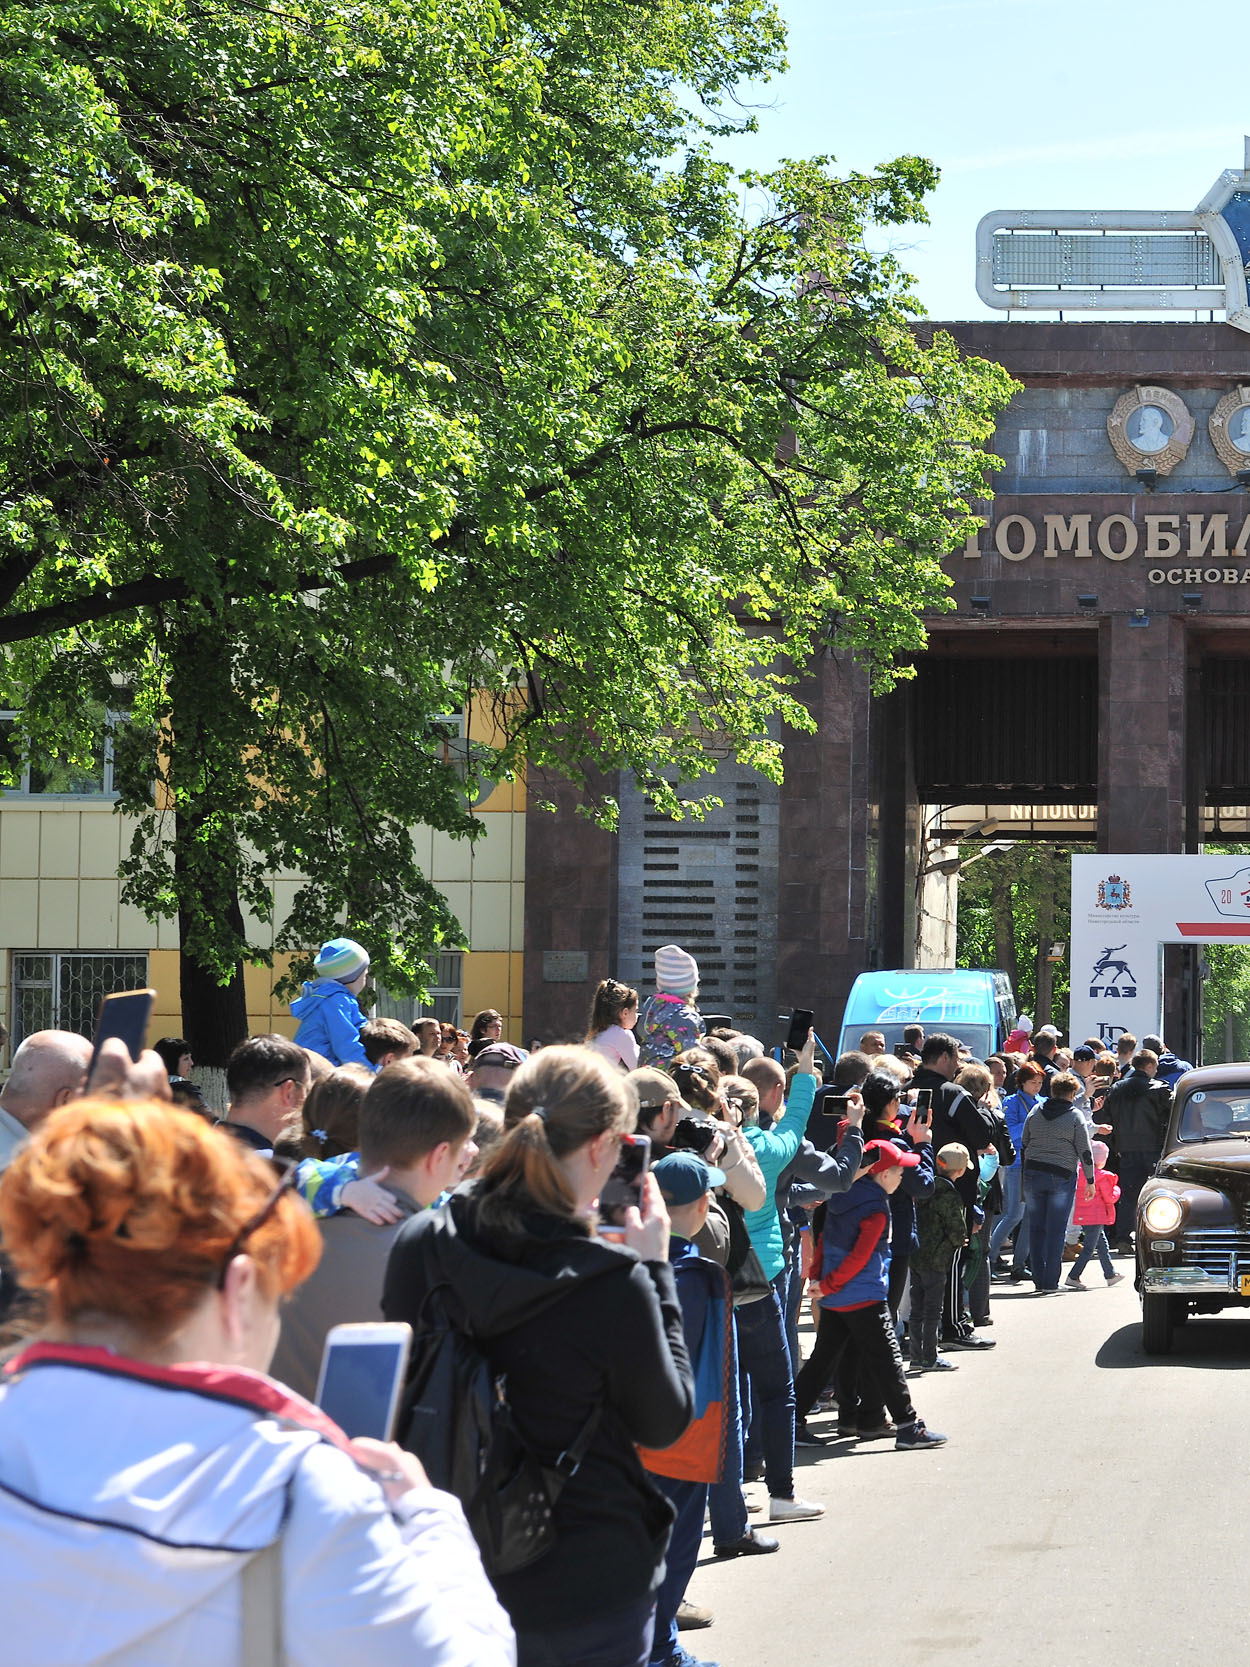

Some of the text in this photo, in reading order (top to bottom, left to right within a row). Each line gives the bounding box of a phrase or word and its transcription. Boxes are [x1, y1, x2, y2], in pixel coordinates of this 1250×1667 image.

[1221, 889, 1232, 904] 20
[1089, 986, 1137, 998] ГАЗ
[1195, 1093, 1203, 1101] 17
